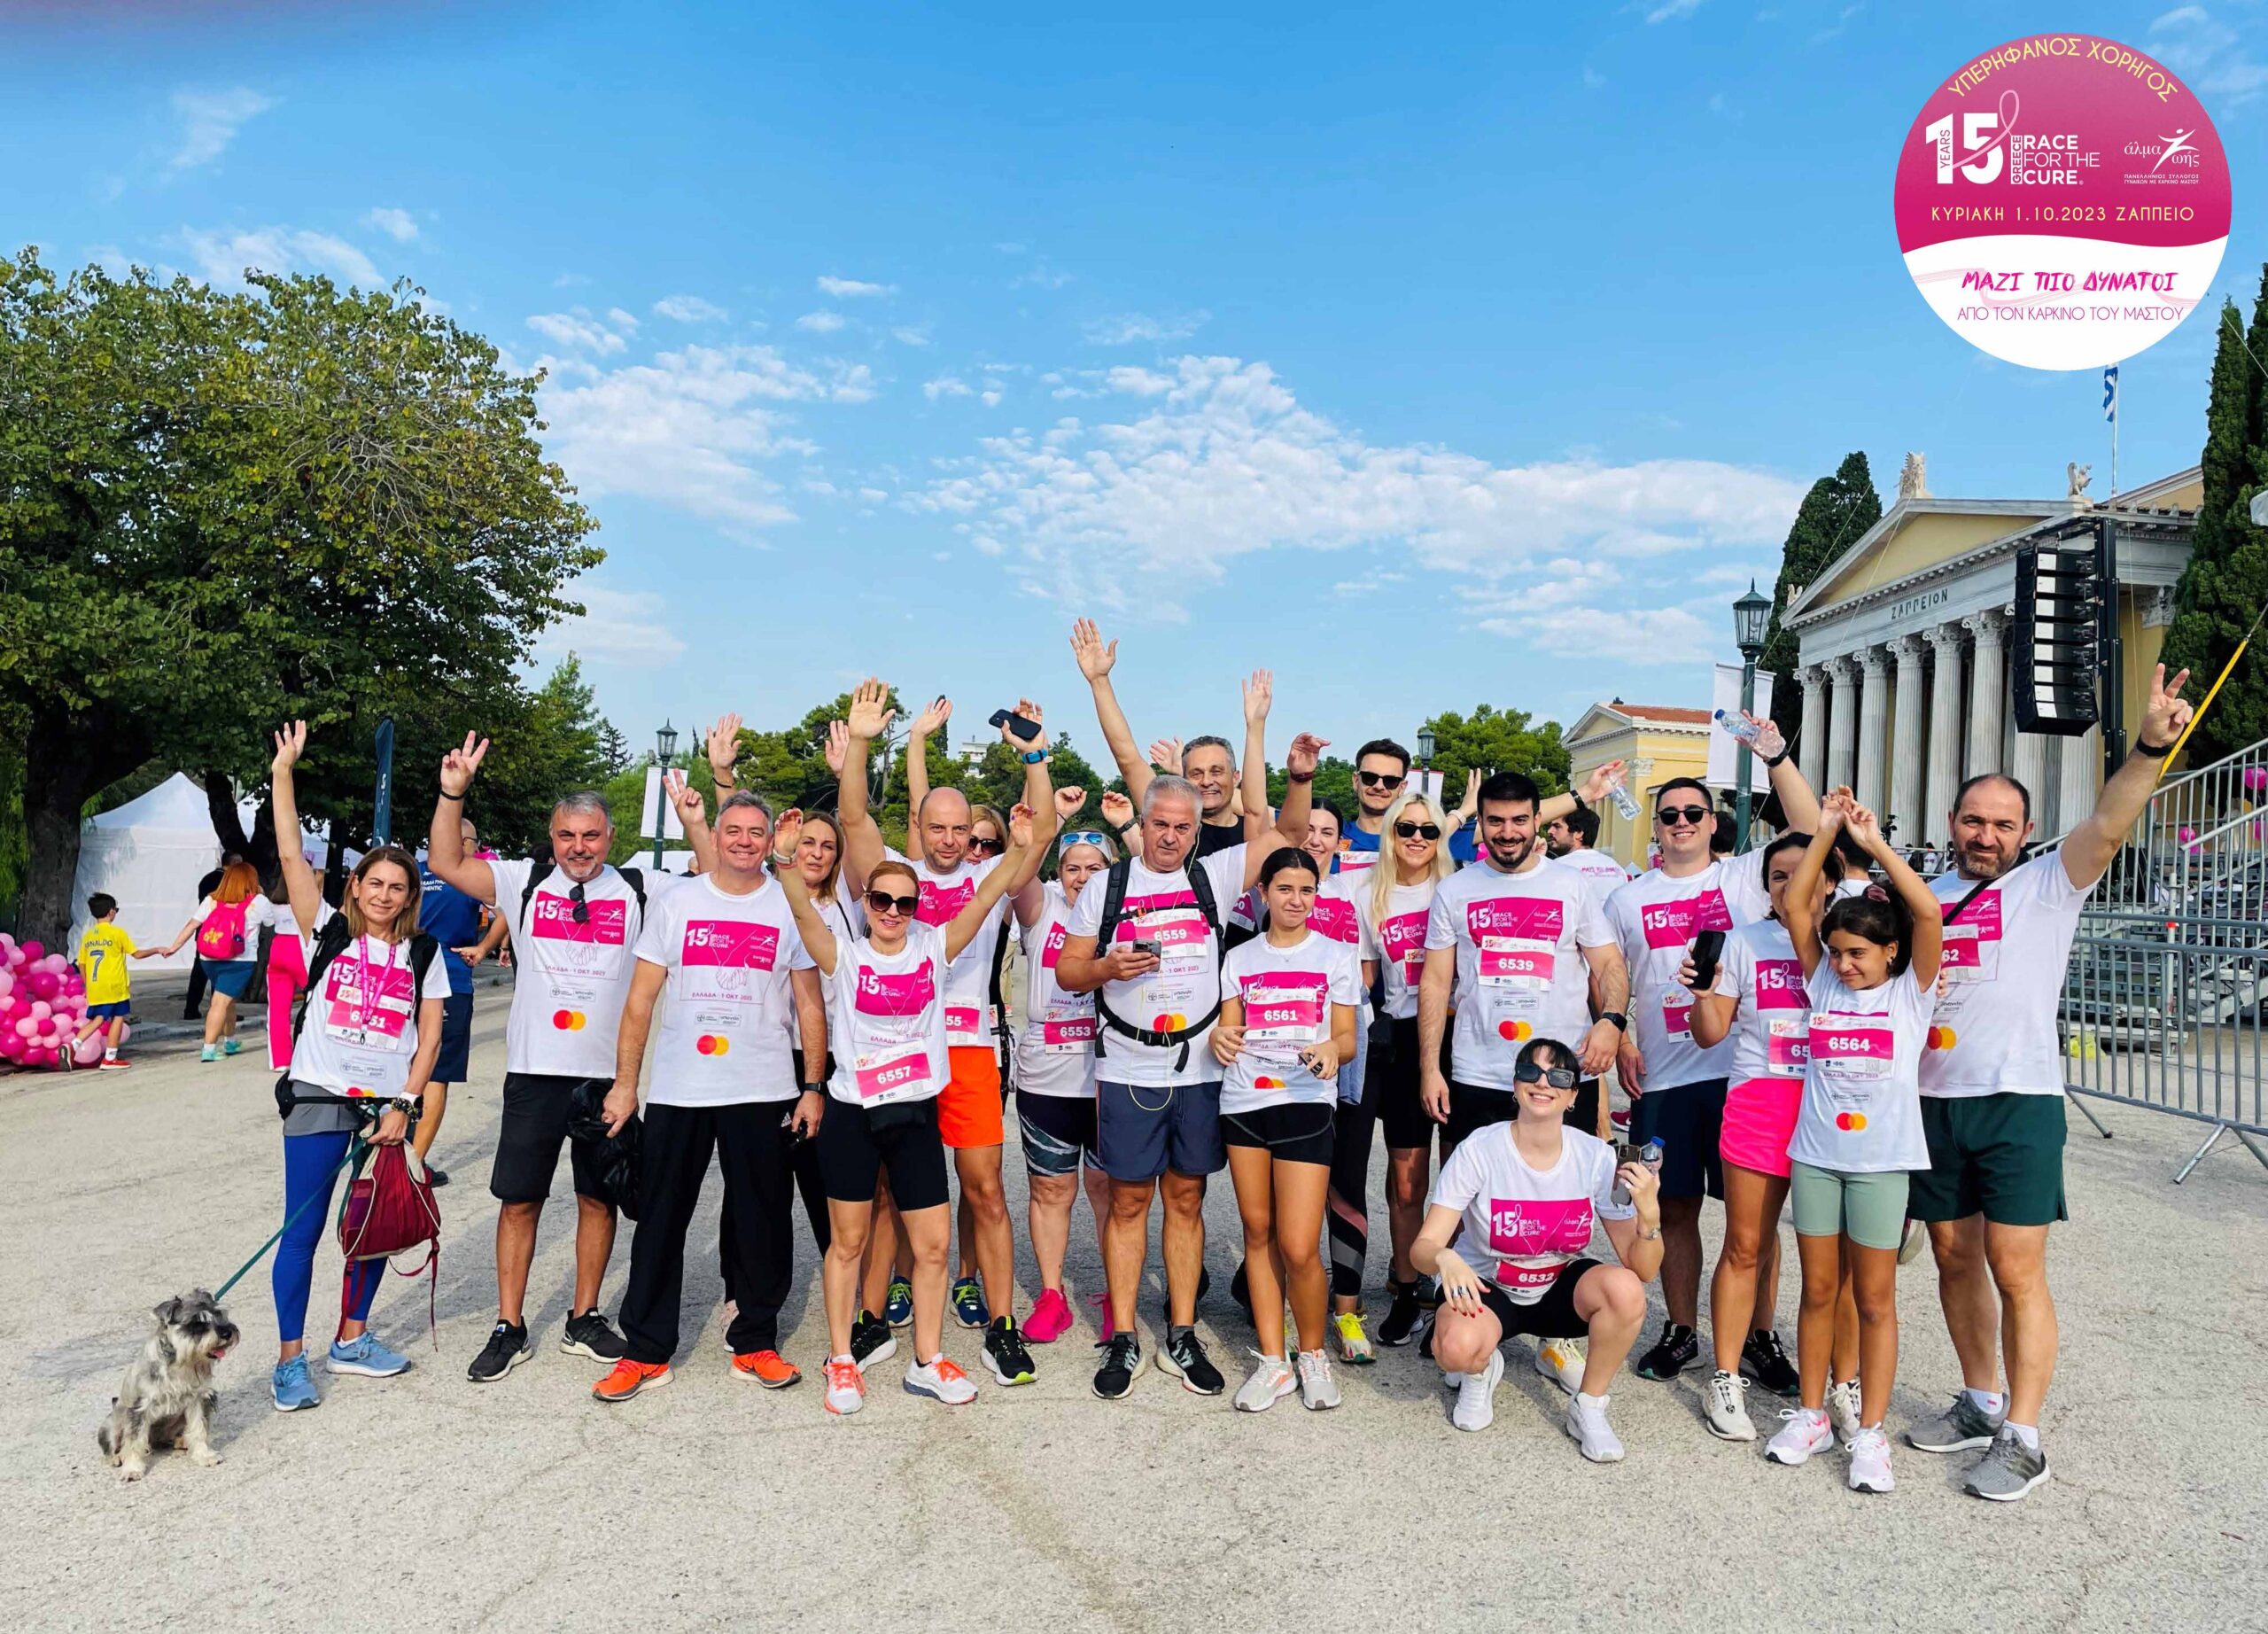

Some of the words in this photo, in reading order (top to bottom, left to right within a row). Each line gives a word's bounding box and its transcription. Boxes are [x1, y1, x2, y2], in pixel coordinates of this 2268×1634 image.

[537, 899, 559, 920] 15
[1469, 907, 1491, 930] 15
[1644, 909, 1667, 930] 15
[687, 928, 709, 947] 15
[1047, 932, 1066, 950] 15
[1153, 929, 1187, 940] 6559
[1382, 923, 1403, 945] 15
[1942, 948, 1960, 961] 62
[89, 949, 105, 982] 7
[333, 961, 355, 984] 15
[1498, 958, 1534, 971] 6539
[859, 974, 880, 995] 15
[1759, 968, 1785, 990] 15
[351, 1010, 385, 1029] 651
[945, 1015, 962, 1027] 55
[1263, 1009, 1298, 1021] 6561
[1060, 1026, 1091, 1037] 6553
[1790, 1045, 1809, 1057] 65
[1829, 1037, 1870, 1052] 6564
[876, 1065, 912, 1085] 6557
[1493, 1210, 1518, 1237] 15
[1518, 1272, 1555, 1283] 6532
